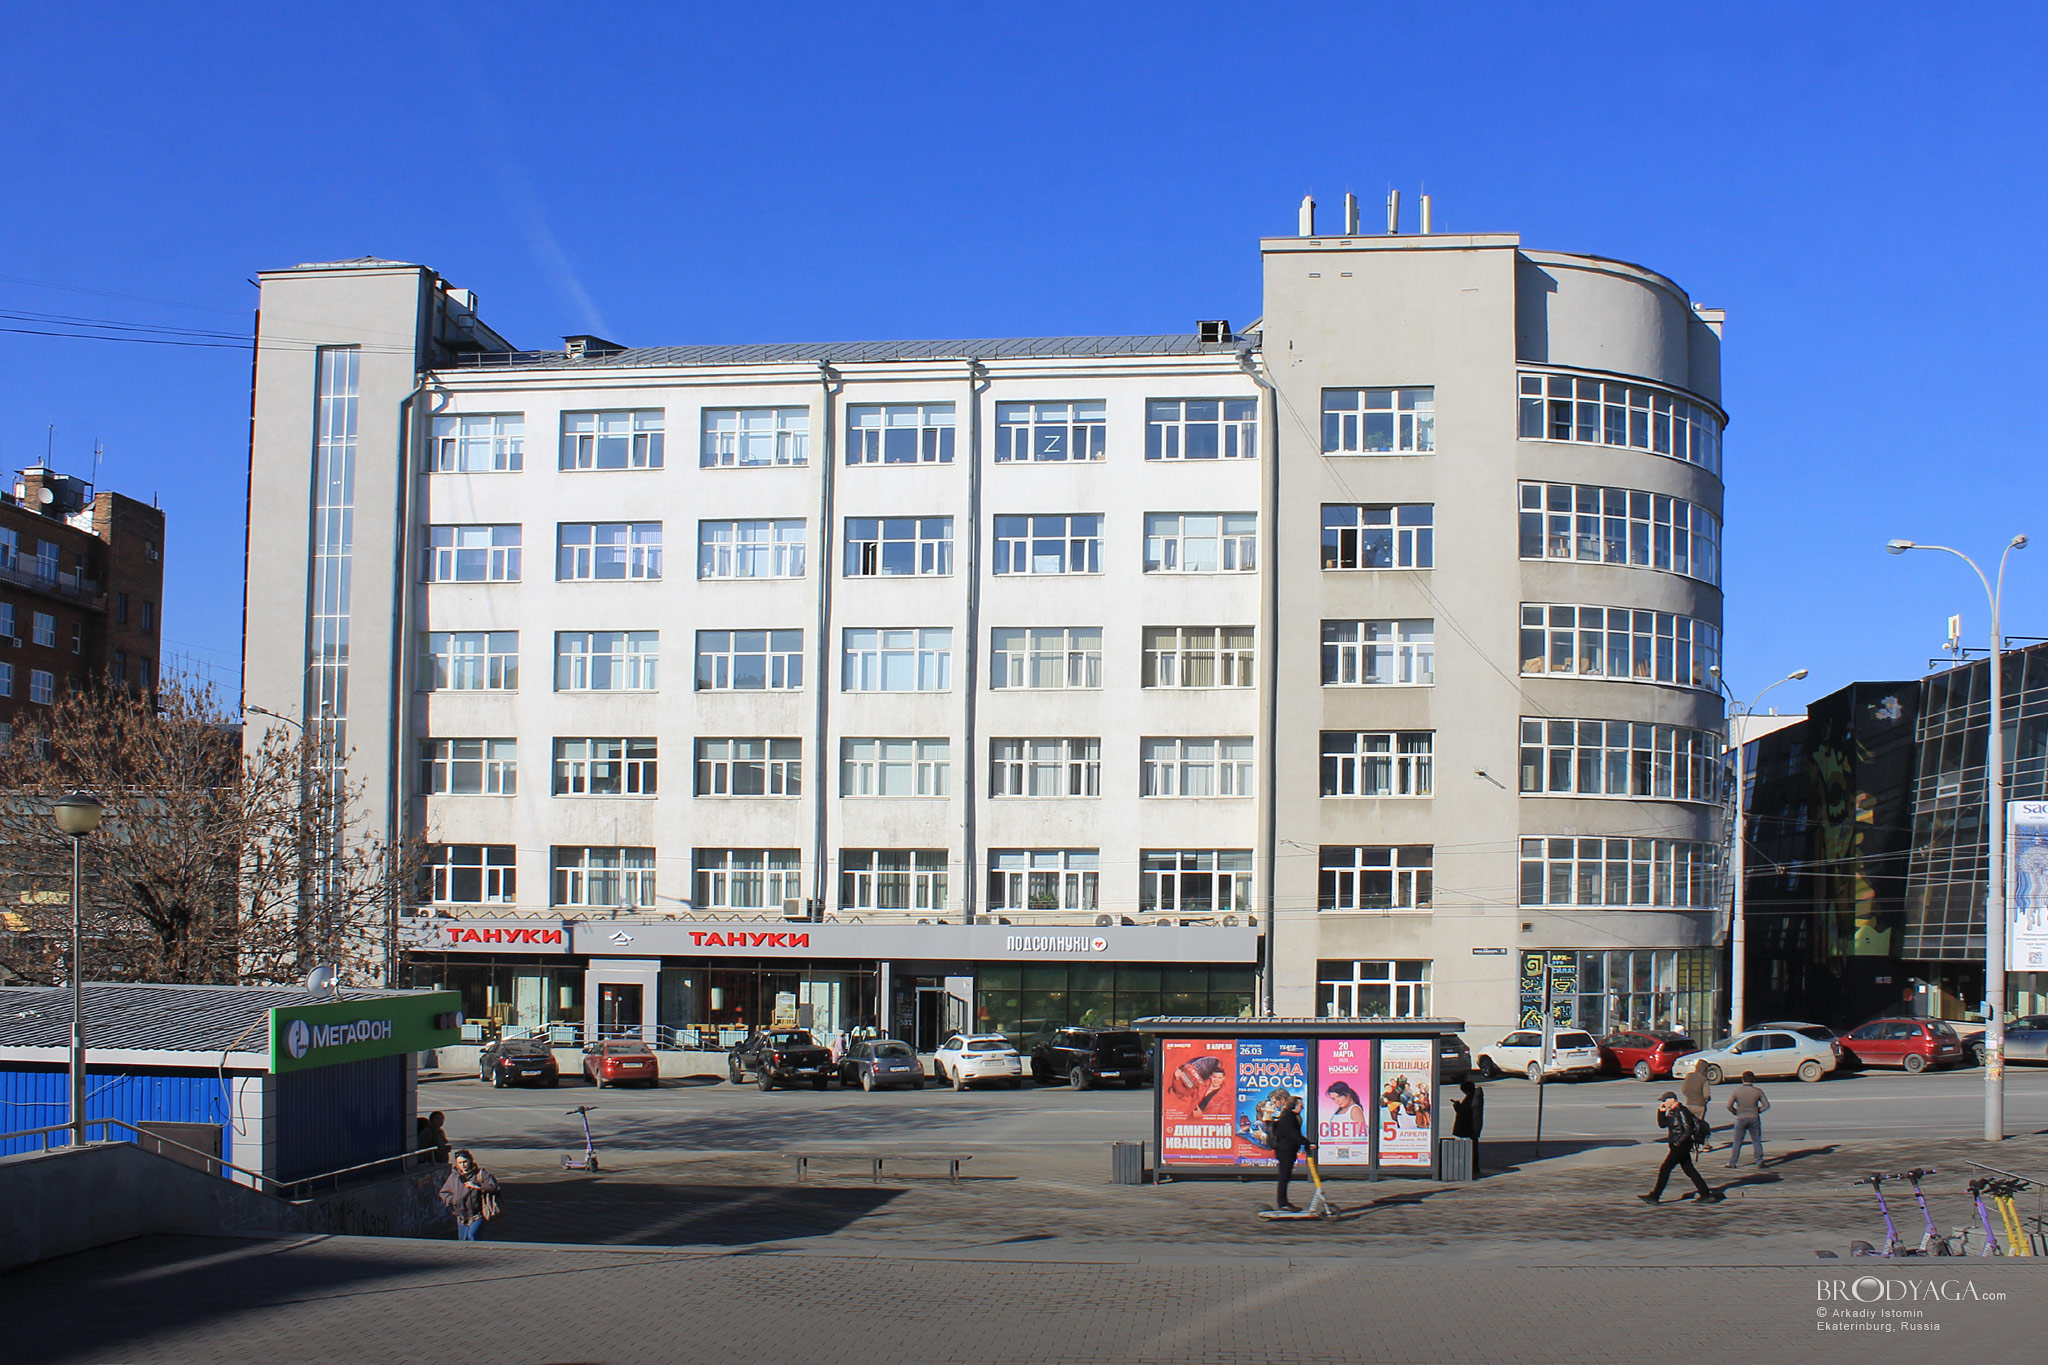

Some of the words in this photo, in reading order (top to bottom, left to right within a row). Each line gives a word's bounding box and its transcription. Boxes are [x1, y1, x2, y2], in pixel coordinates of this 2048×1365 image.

[1044, 435, 1060, 453] Z
[446, 928, 562, 944] ТАНУКИ
[688, 931, 809, 948] ТАНУКИ
[1007, 936, 1090, 951] ПОДСОЛНУХИ
[1239, 1047, 1262, 1056] 26.03
[1338, 1041, 1349, 1050] 20
[1333, 1050, 1354, 1058] МАРТА
[1239, 1062, 1304, 1076] ЮНОНА
[1328, 1065, 1359, 1073] КОСМОС
[1173, 1122, 1232, 1136] ДМИТРИЙ
[1319, 1121, 1368, 1137] СВЕТА
[1383, 1121, 1397, 1141] 5
[1165, 1136, 1232, 1150] ИВАЩЕНКО
